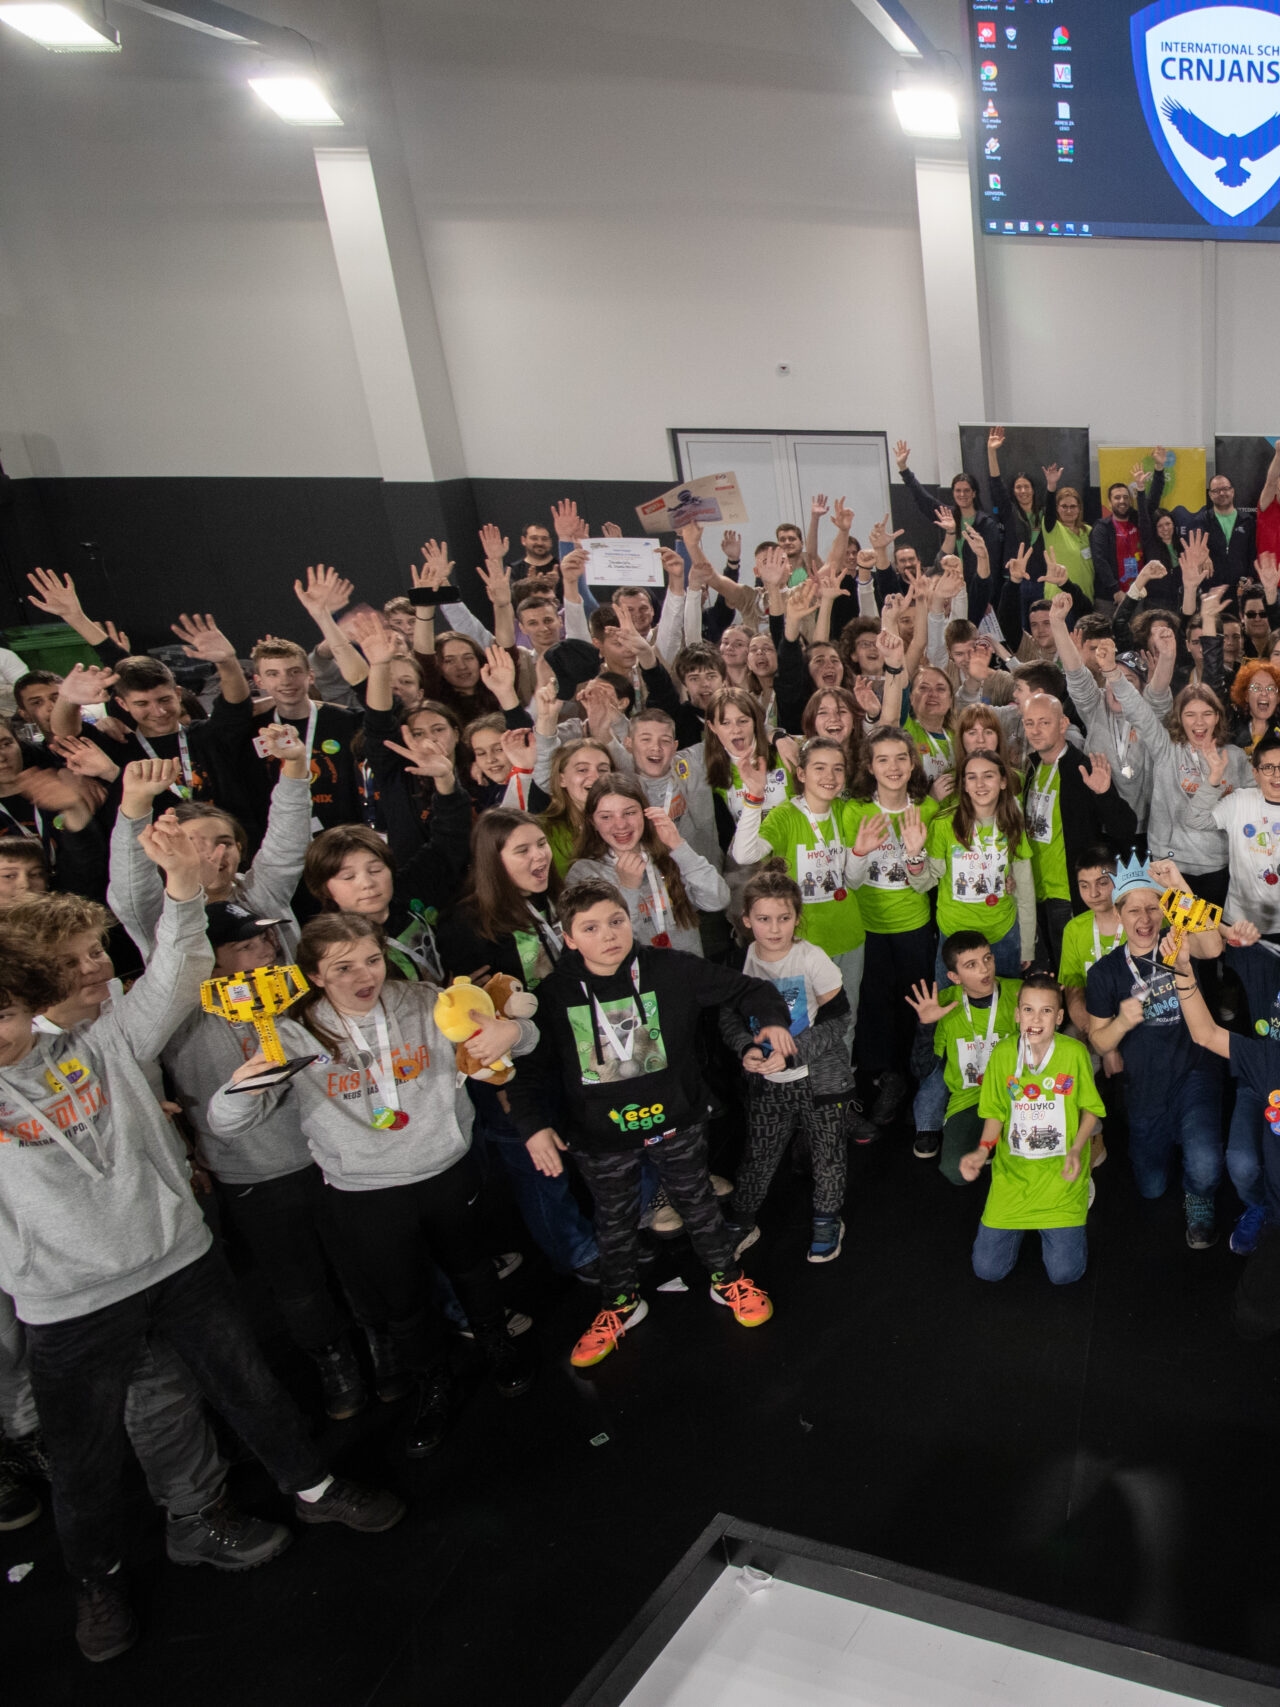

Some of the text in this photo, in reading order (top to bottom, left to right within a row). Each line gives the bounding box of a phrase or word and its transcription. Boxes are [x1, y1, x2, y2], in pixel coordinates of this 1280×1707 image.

[1161, 41, 1254, 56] INTERNATIONAL
[1144, 997, 1179, 1019] KING
[625, 1103, 664, 1121] eco
[619, 1113, 666, 1132] lego
